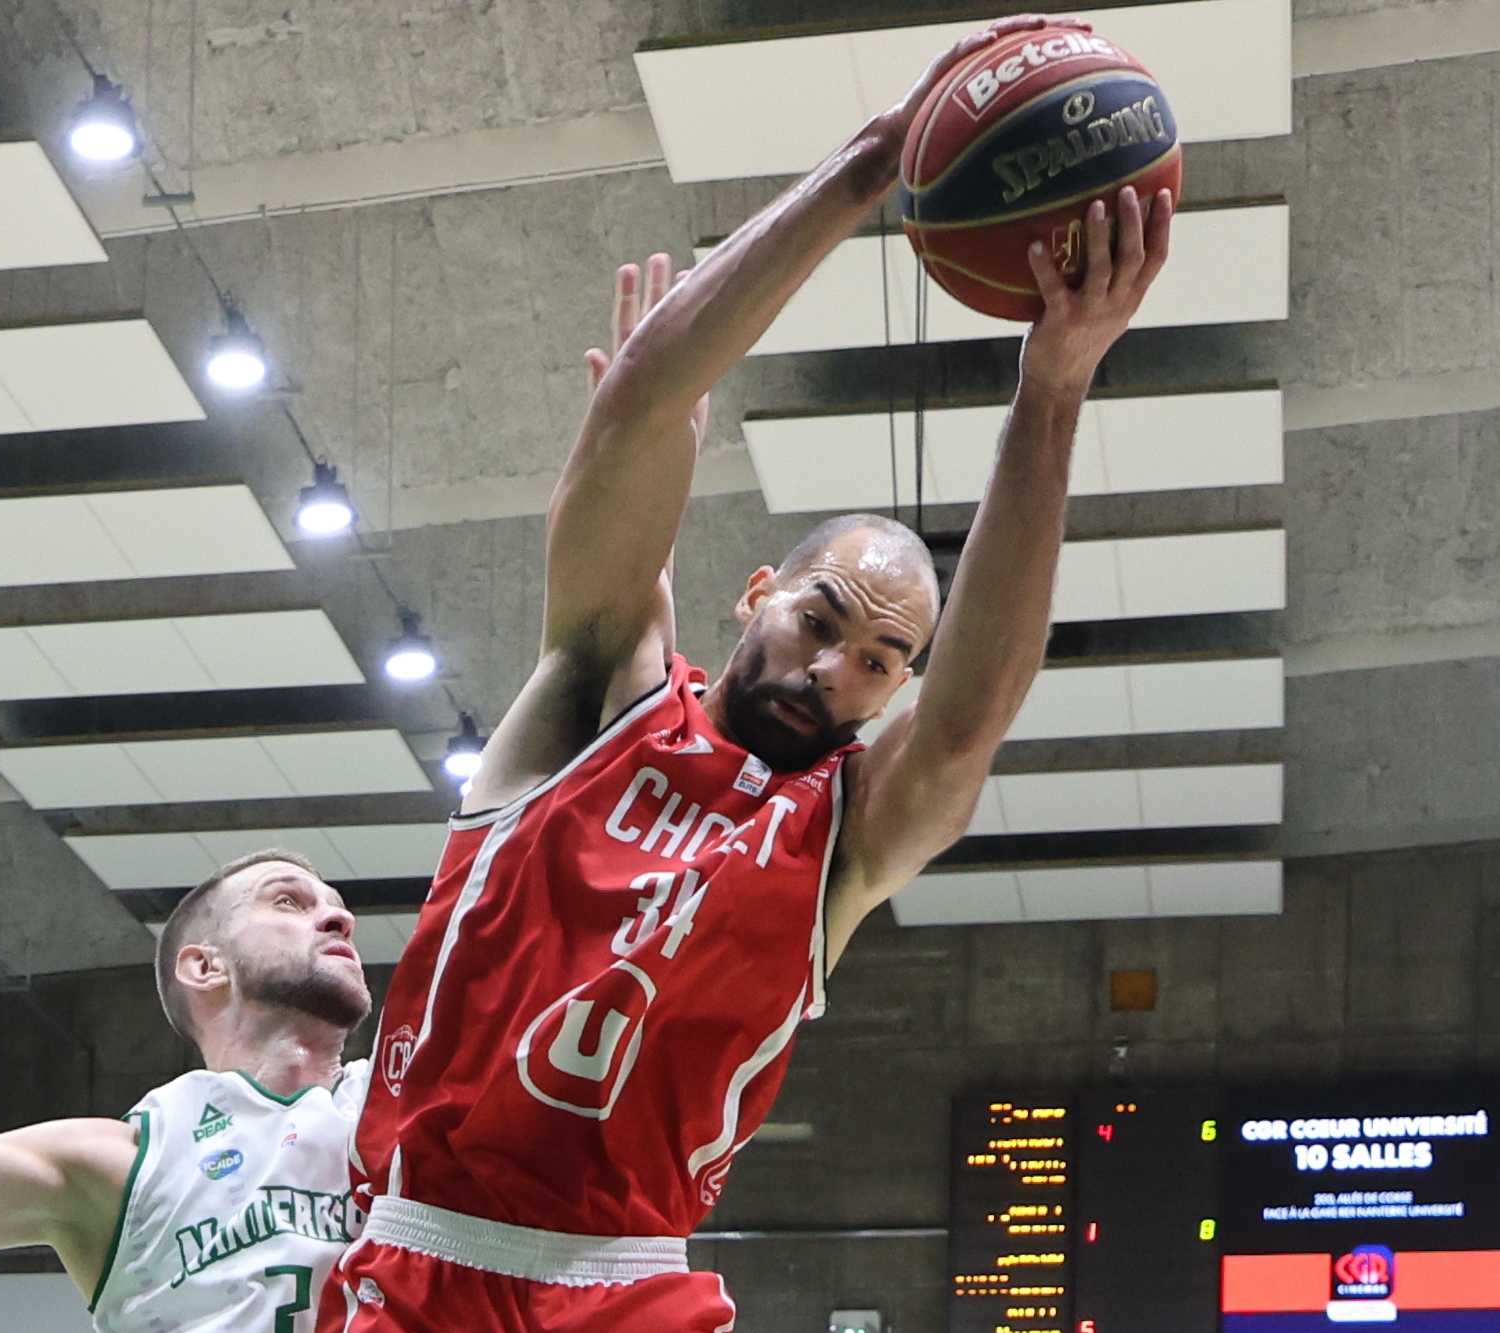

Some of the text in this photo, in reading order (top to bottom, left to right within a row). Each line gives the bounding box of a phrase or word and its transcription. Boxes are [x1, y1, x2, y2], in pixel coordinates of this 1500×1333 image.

[992, 95, 1172, 203] SPALDING
[610, 871, 709, 959] 34
[193, 1114, 234, 1142] PEAK
[1097, 1125, 1114, 1141] 4
[1201, 1120, 1217, 1141] 6
[1363, 1109, 1488, 1138] UNIVERSITÉ
[203, 1156, 241, 1171] ICADE
[1295, 1142, 1433, 1170] 10 SALLES
[1087, 1221, 1098, 1242] 1
[1199, 1219, 1216, 1240] 8
